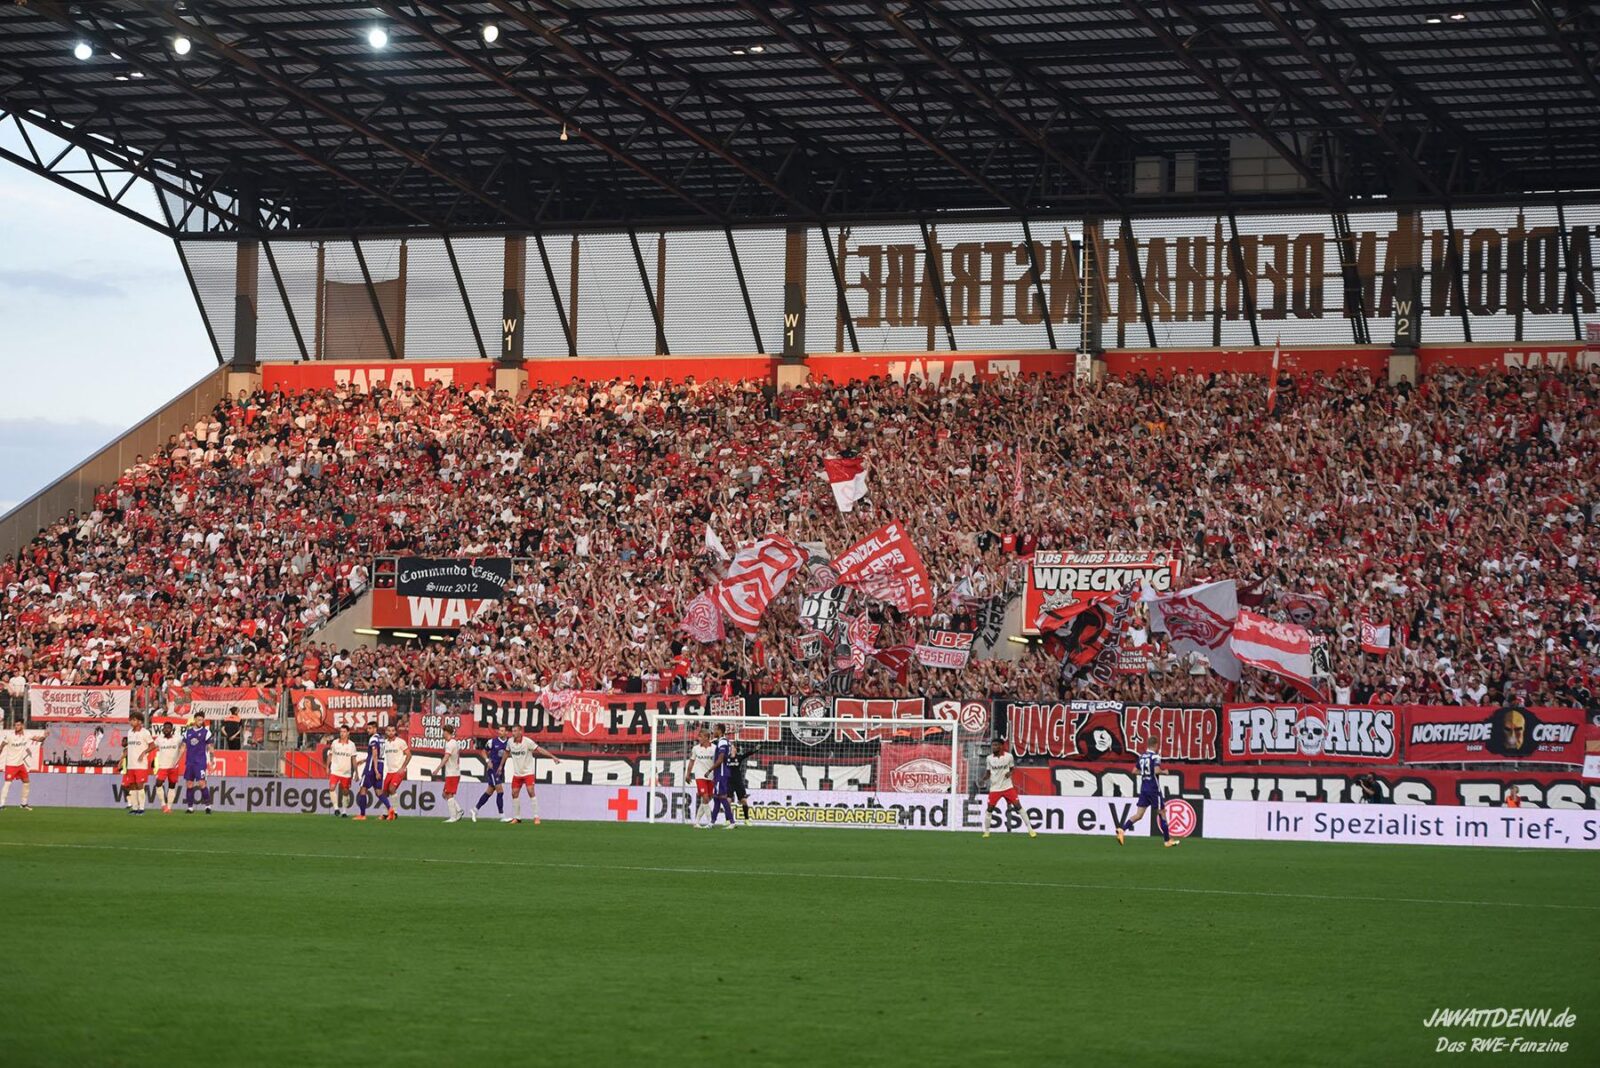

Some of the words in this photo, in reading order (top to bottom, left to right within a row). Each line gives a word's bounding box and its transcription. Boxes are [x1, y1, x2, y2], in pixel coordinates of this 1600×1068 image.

[1396, 301, 1412, 315] W
[502, 319, 517, 332] W
[784, 313, 799, 327] W
[1398, 319, 1409, 335] 2
[505, 335, 511, 351] 1
[786, 329, 794, 346] 1
[1038, 553, 1062, 565] LOS
[400, 565, 467, 583] Commando
[468, 564, 506, 587] Essen
[1033, 567, 1172, 592] WRECKING
[426, 582, 454, 593] Since
[455, 583, 479, 593] 2012
[42, 690, 81, 703] Essener
[328, 693, 393, 710] HAFENSÄNGER
[43, 703, 83, 718] Jungs
[607, 698, 701, 735] FANS
[333, 711, 389, 729] ESSEN
[1003, 703, 1081, 758] JUNGE
[1124, 705, 1218, 760] ESSENER
[1411, 722, 1493, 744] NORTHSIDE
[1532, 723, 1575, 743] CREW
[1267, 811, 1304, 833] Ihr
[1314, 812, 1444, 840] Spezialist
[1456, 816, 1488, 838] im
